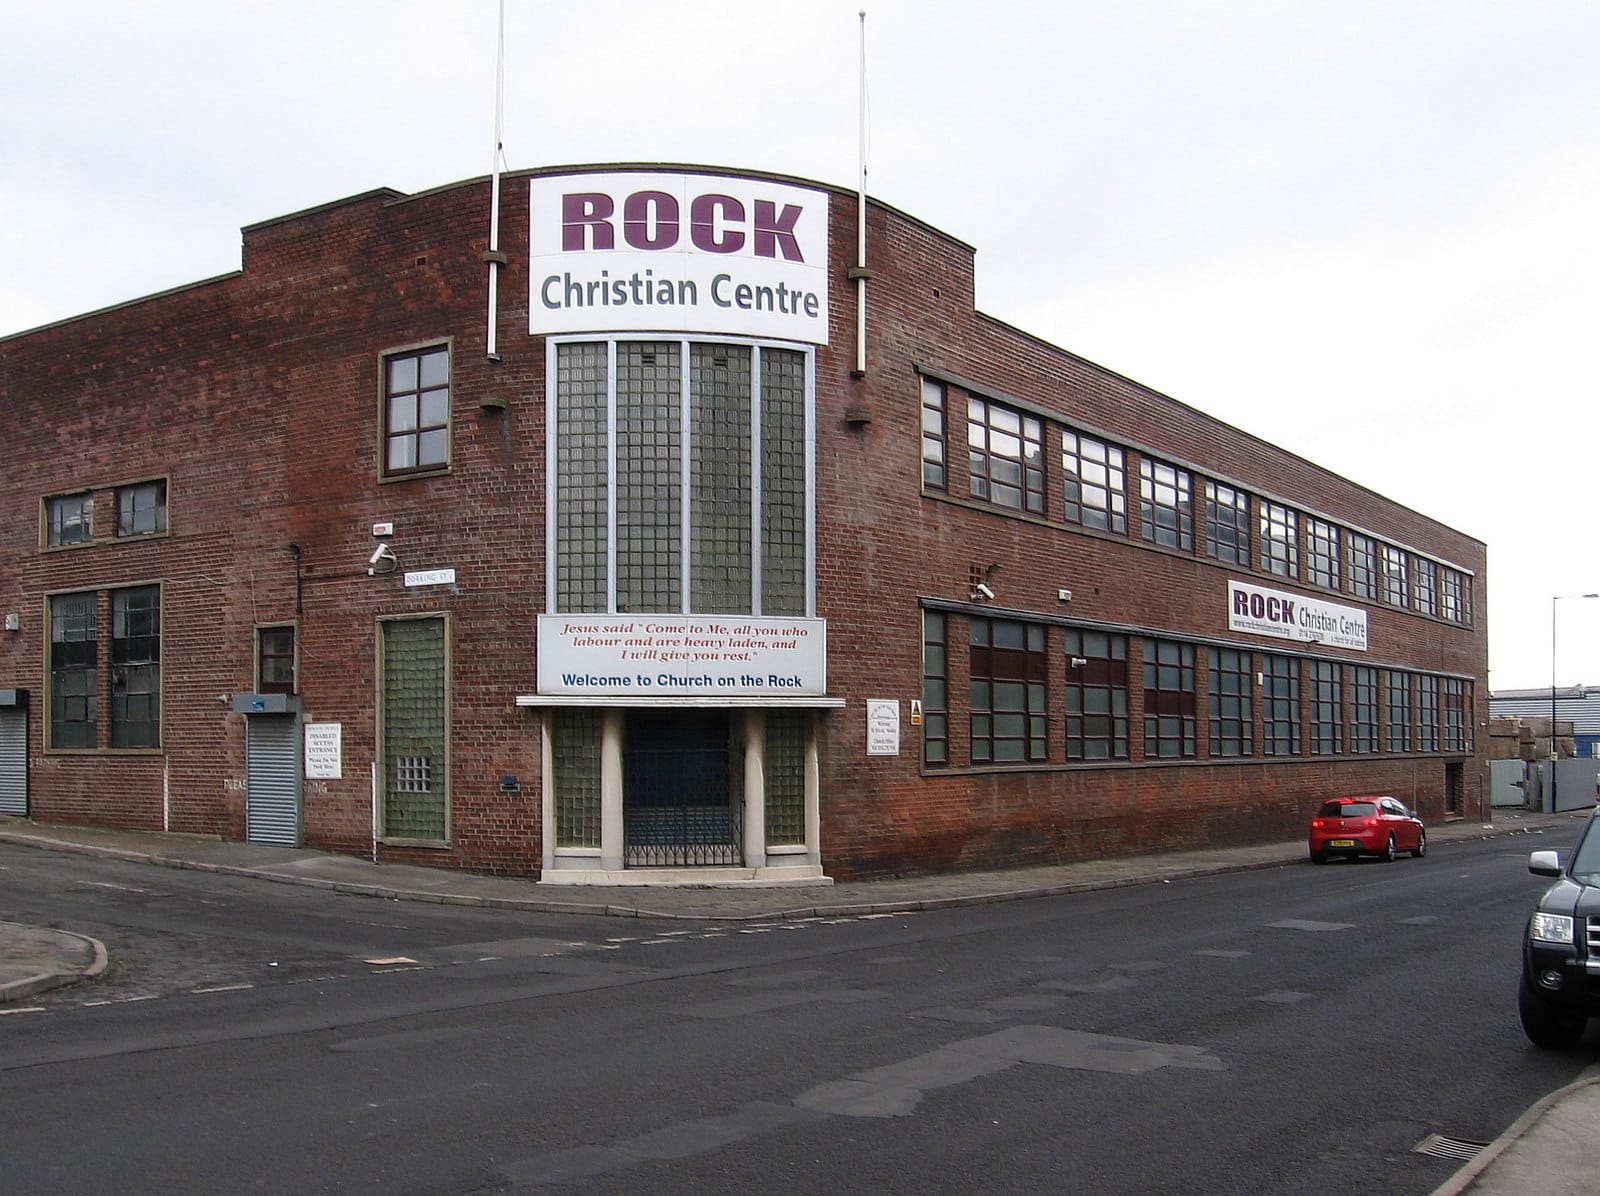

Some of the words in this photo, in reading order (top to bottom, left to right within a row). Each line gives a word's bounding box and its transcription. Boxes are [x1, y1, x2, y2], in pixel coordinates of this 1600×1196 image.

[562, 190, 804, 263] ROCK
[541, 269, 697, 309] Christian
[710, 274, 819, 318] Centre
[1233, 589, 1296, 625] ROCK
[1299, 606, 1337, 632] Christian
[1340, 616, 1365, 638] Centre
[559, 623, 600, 636] Jesus
[602, 623, 634, 634] said
[689, 624, 703, 634] to
[707, 624, 729, 635] Me,
[733, 625, 751, 635] all
[752, 628, 778, 638] you
[781, 626, 808, 637] who
[572, 636, 621, 647] labour
[624, 637, 653, 647] and
[656, 639, 681, 647] are
[683, 637, 725, 650] heavy
[728, 638, 768, 650] laden,
[771, 640, 797, 649] and
[620, 650, 627, 660] I
[630, 650, 657, 660] will
[659, 650, 690, 662] give
[691, 652, 719, 662] you
[562, 673, 632, 686] Welcome
[637, 674, 652, 686] to
[657, 673, 713, 687] Church
[718, 676, 735, 686] on
[740, 674, 763, 687] the
[768, 674, 803, 688] Rock
